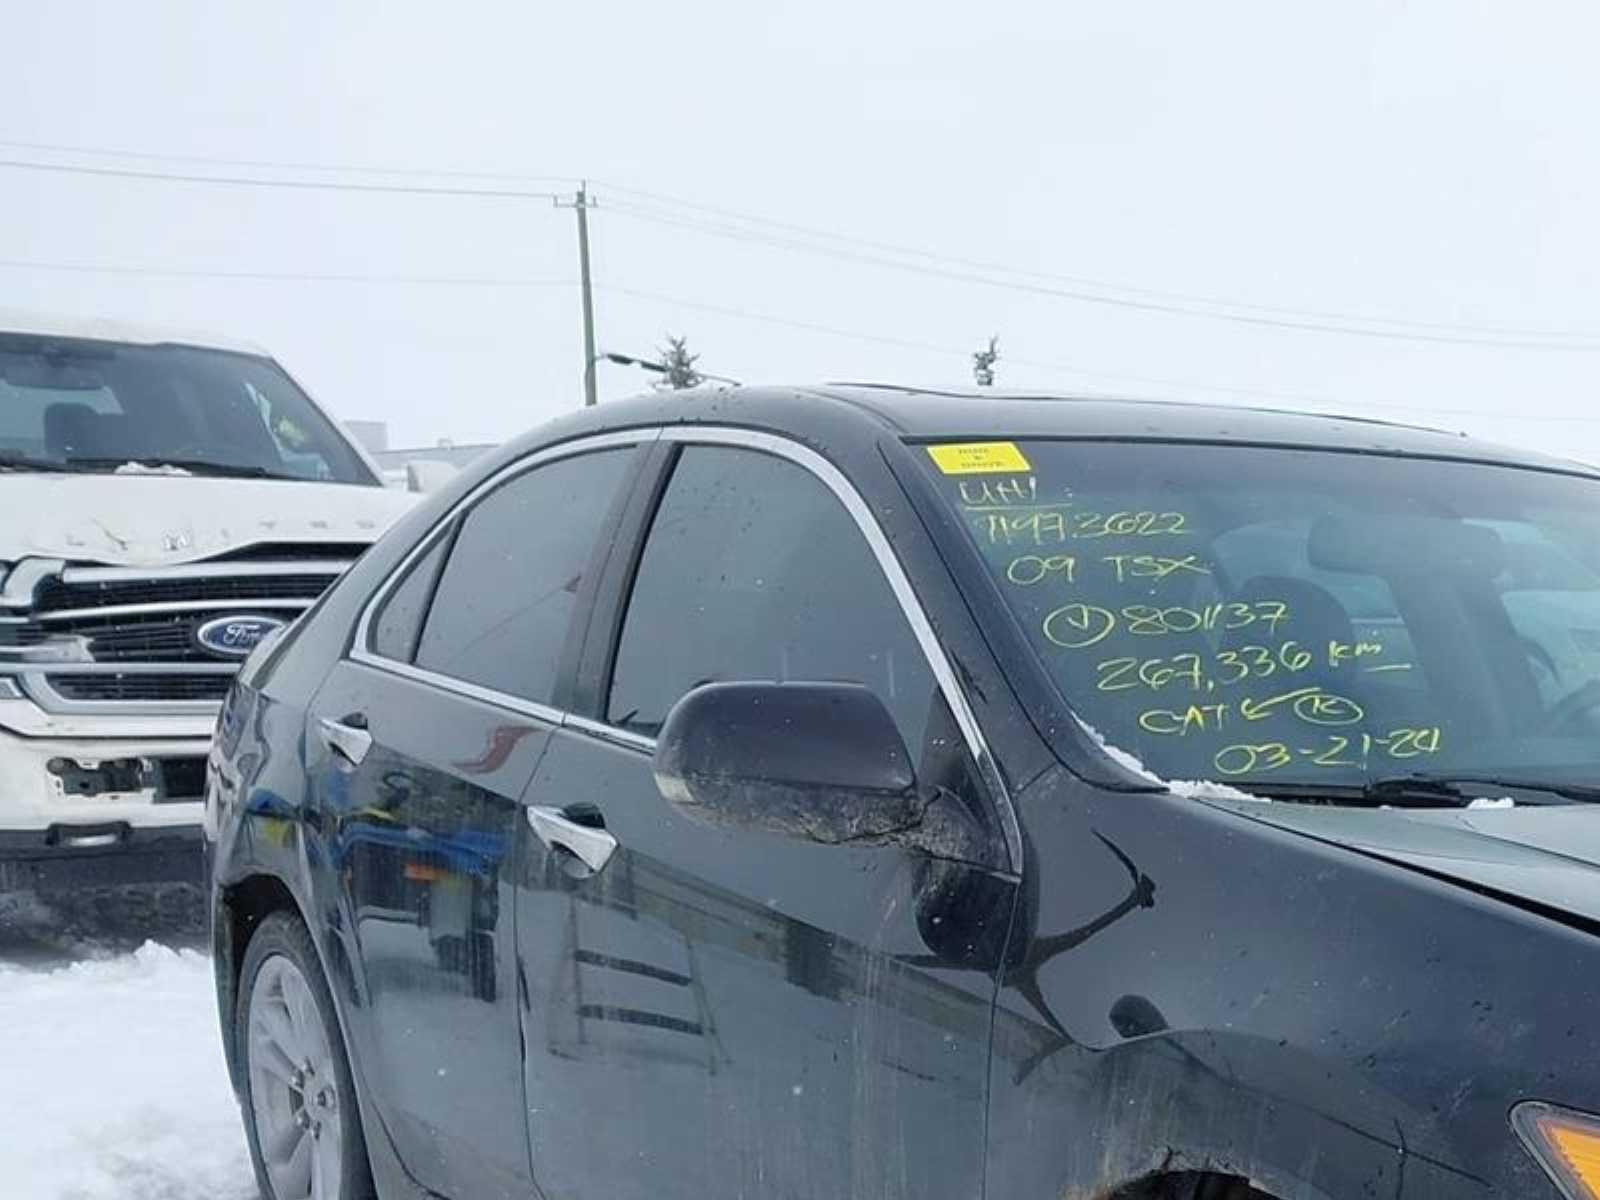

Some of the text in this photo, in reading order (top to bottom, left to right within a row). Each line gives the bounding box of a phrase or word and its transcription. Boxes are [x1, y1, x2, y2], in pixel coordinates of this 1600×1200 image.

[988, 511, 1186, 545] 11973622
[1007, 554, 1212, 585] 09 TSX
[1139, 702, 1230, 736] CAT
